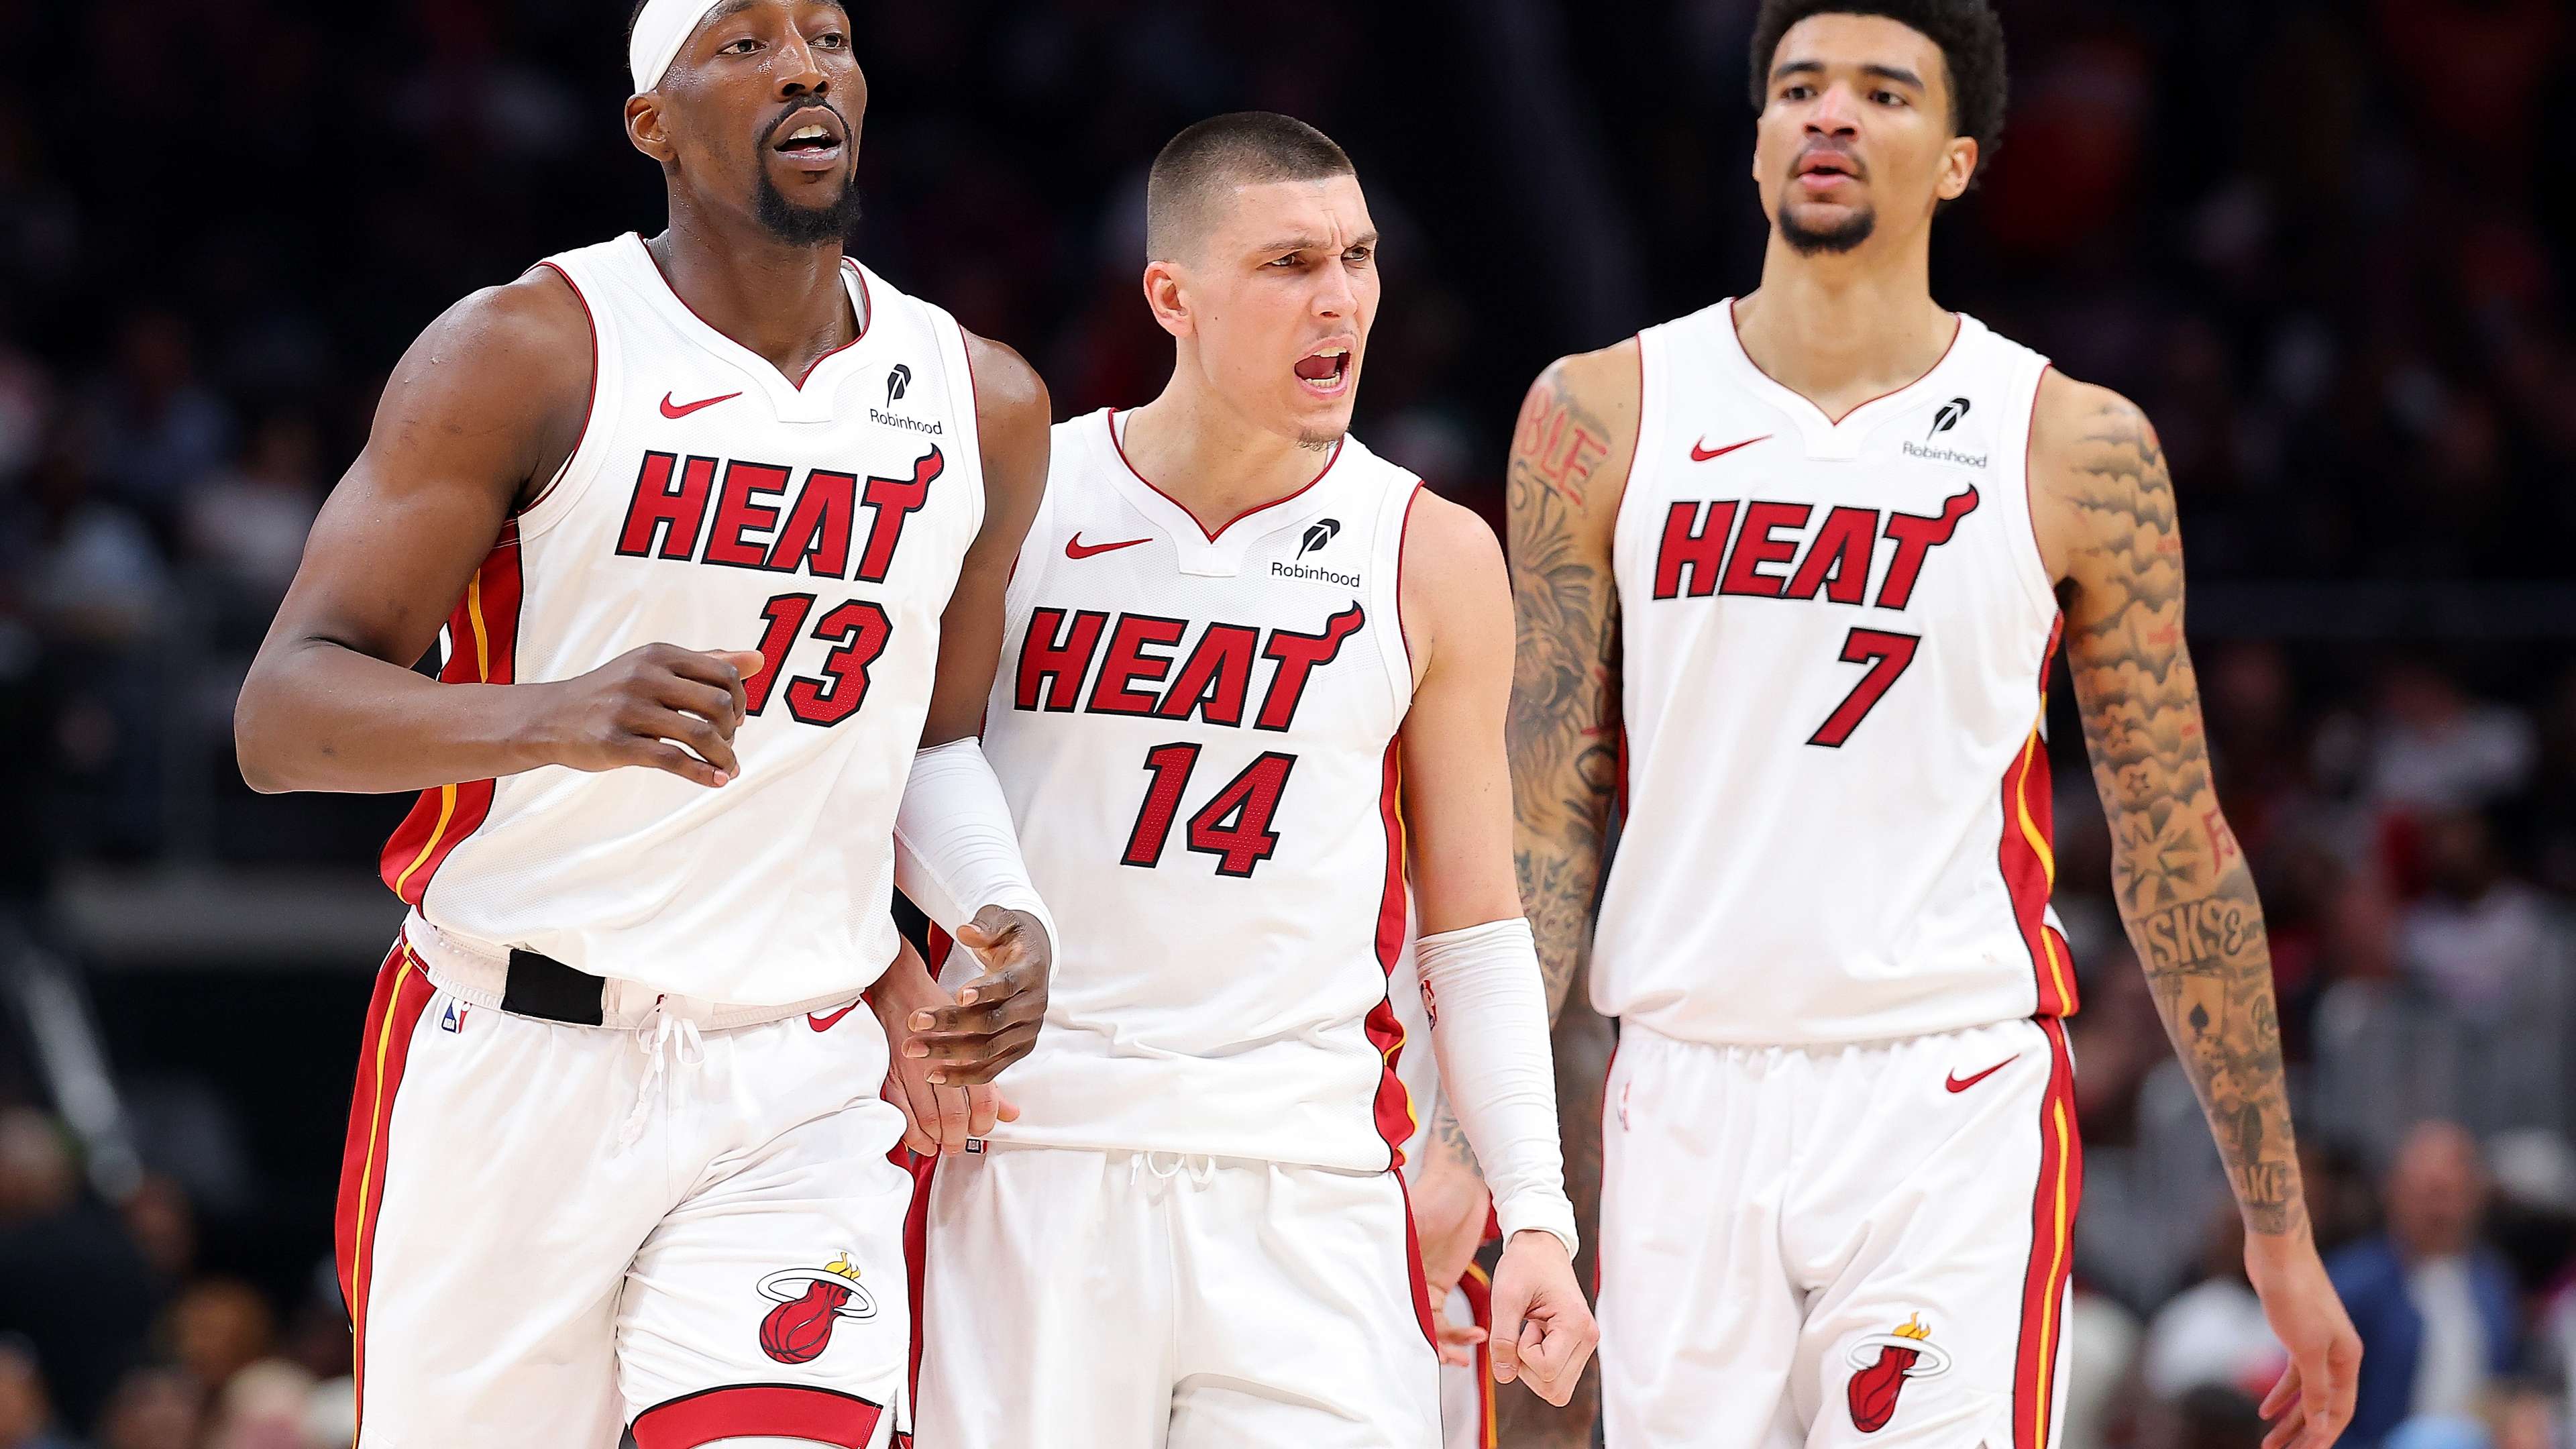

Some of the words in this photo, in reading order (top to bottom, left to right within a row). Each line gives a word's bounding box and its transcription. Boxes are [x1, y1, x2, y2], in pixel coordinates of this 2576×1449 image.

[869, 408, 943, 435] Robinhood
[1902, 441, 1987, 468] Robinhood
[614, 443, 944, 584] HEAT
[1271, 561, 1360, 588] Robinhood
[1653, 484, 1979, 611] HEAT
[744, 592, 893, 729] 13
[1014, 600, 1365, 733] HEAT
[1805, 627, 1922, 749] 7
[1120, 741, 1298, 879] 14
